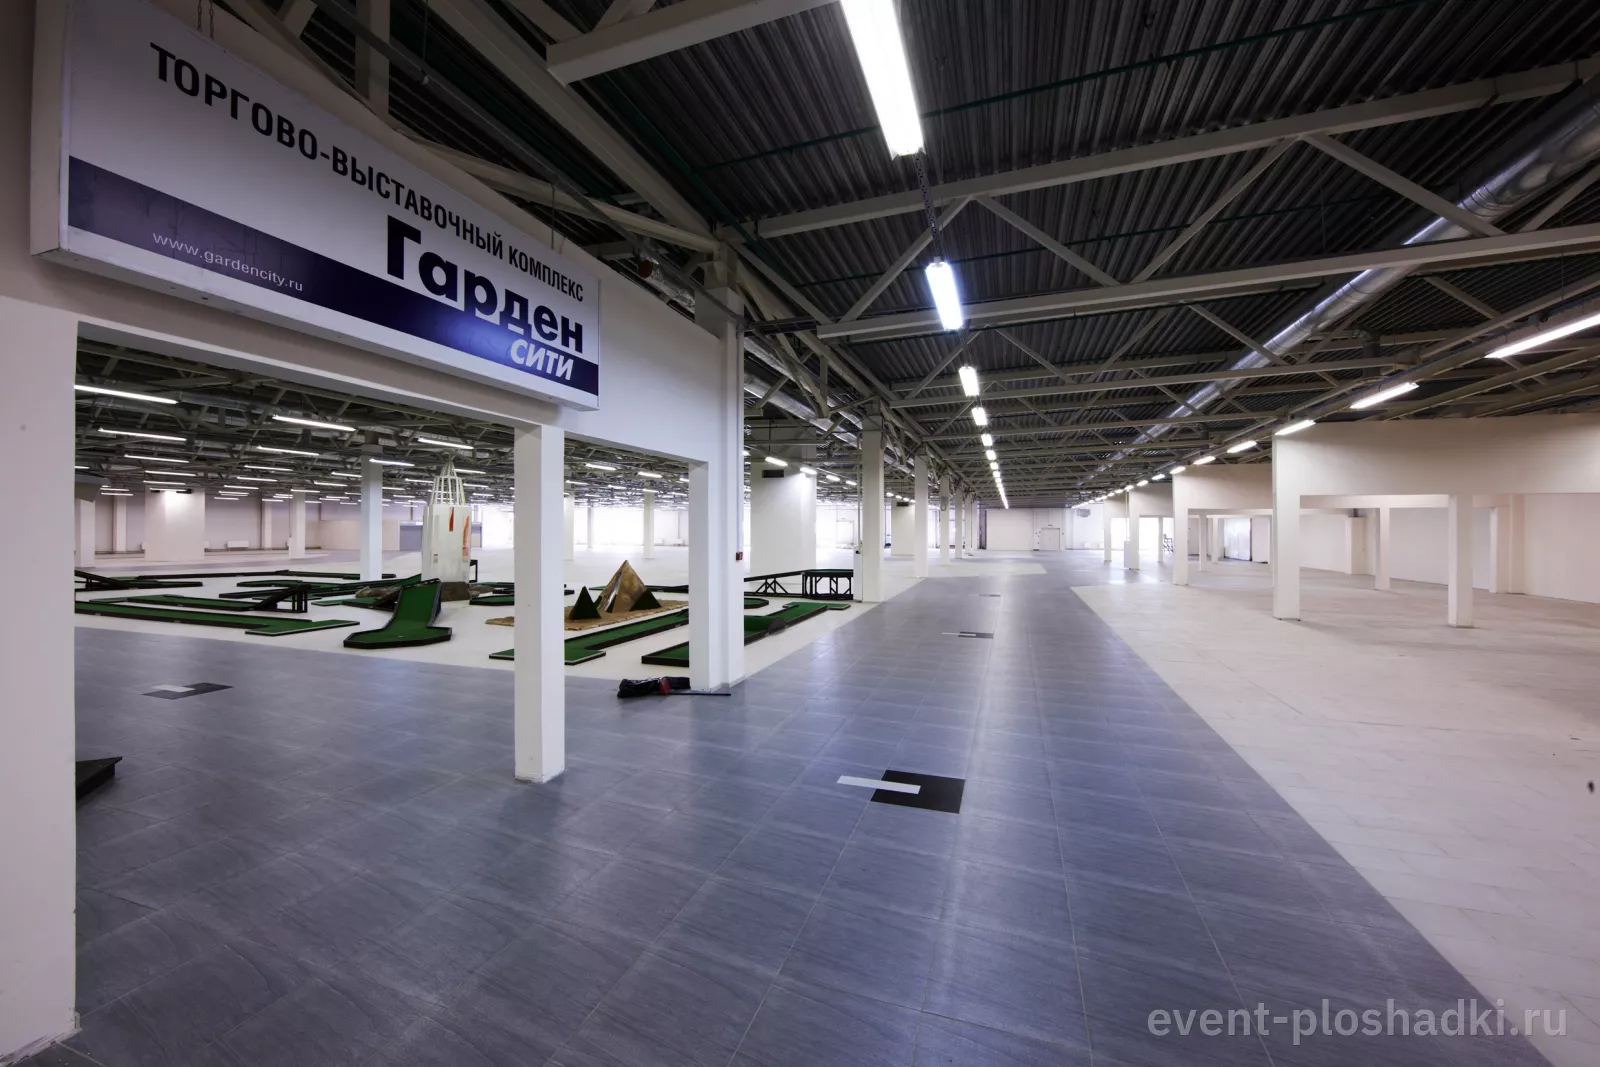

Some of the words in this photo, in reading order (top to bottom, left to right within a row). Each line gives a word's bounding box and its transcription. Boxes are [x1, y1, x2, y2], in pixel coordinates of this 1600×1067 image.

[149, 42, 503, 260] ТОРГОВО-ВЫСТАВОЧНЫЙ
[508, 245, 584, 302] КОМПЛЕКС
[152, 231, 304, 291] www.gardencity.ru
[387, 216, 583, 354] Гарден
